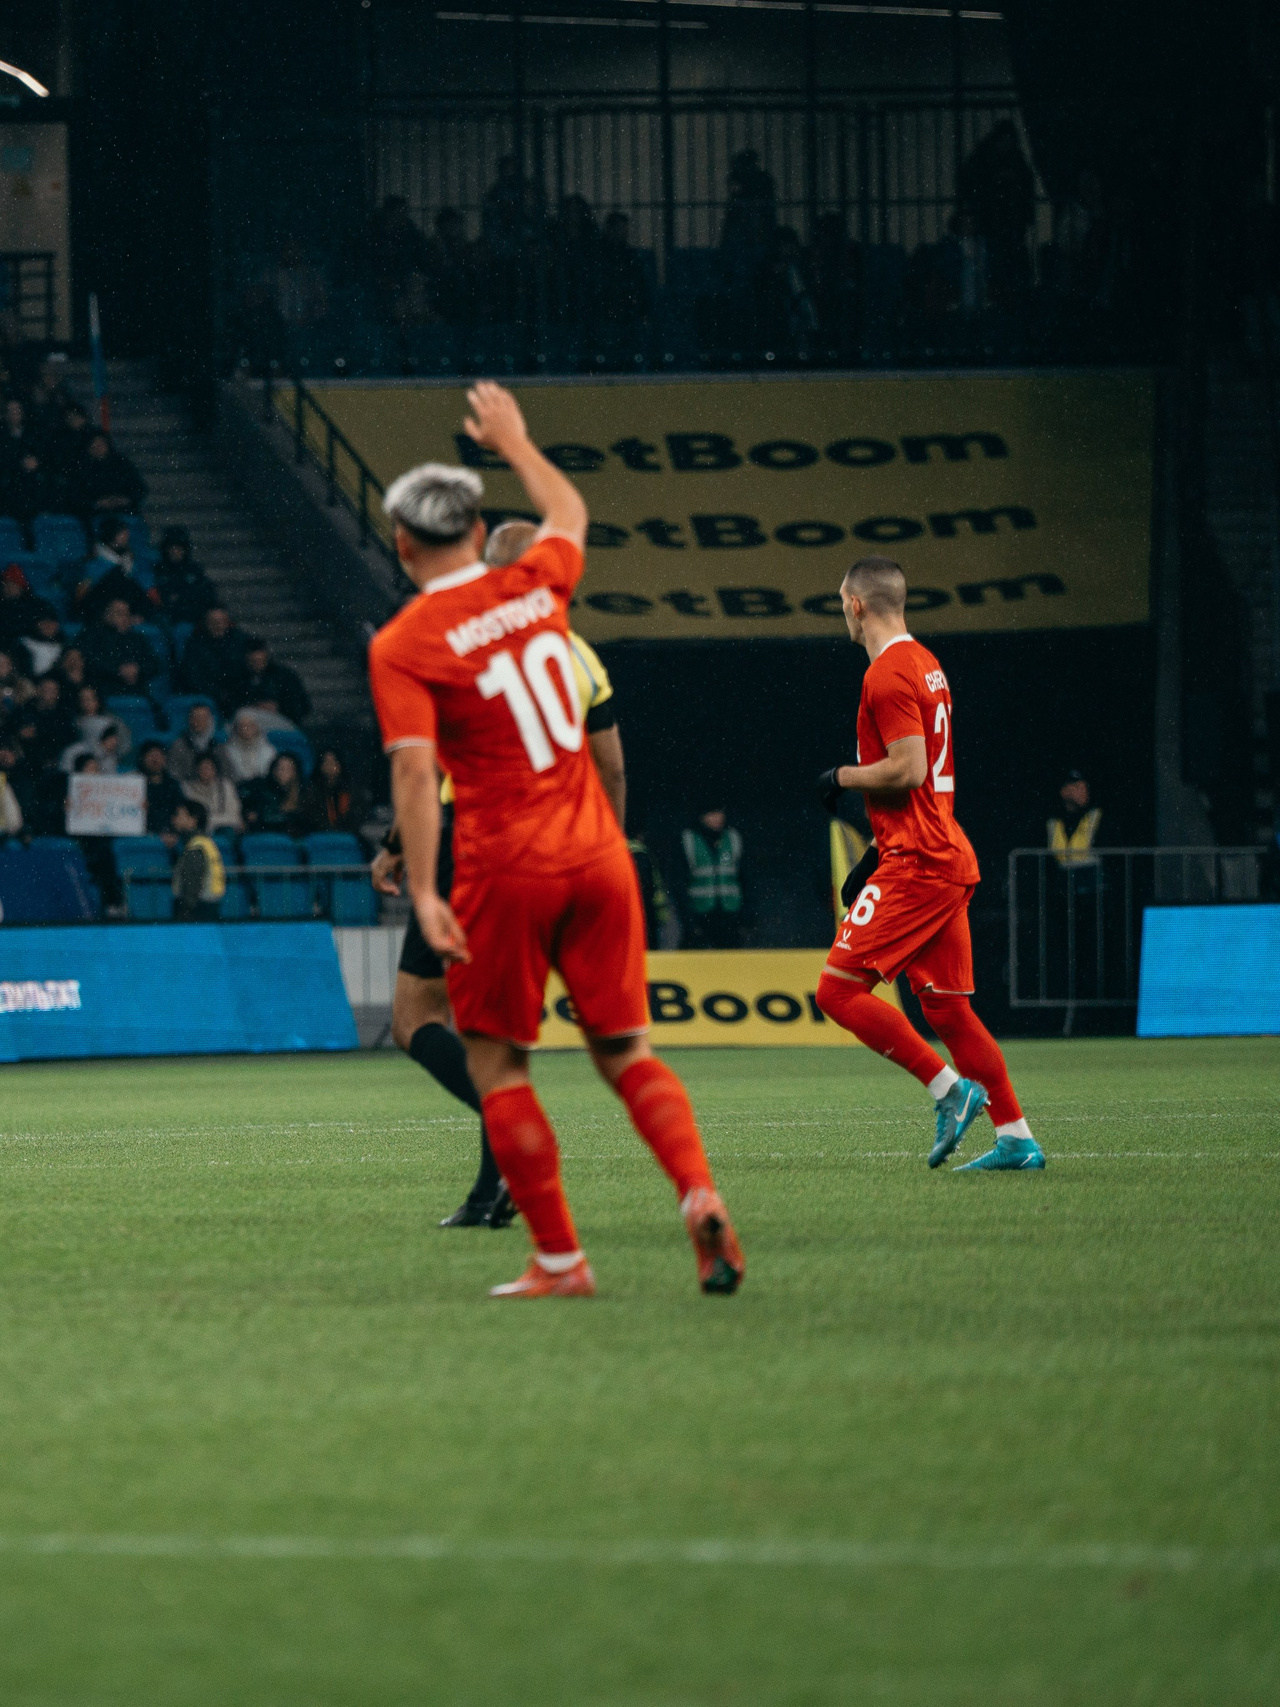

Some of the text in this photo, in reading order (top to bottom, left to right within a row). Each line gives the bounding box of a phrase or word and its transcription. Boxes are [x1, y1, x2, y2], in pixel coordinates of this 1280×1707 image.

[480, 506, 1038, 548] etBoom
[570, 573, 1065, 618] etBoom
[476, 631, 582, 773] 10
[932, 702, 954, 793] 2
[843, 884, 882, 927] 6
